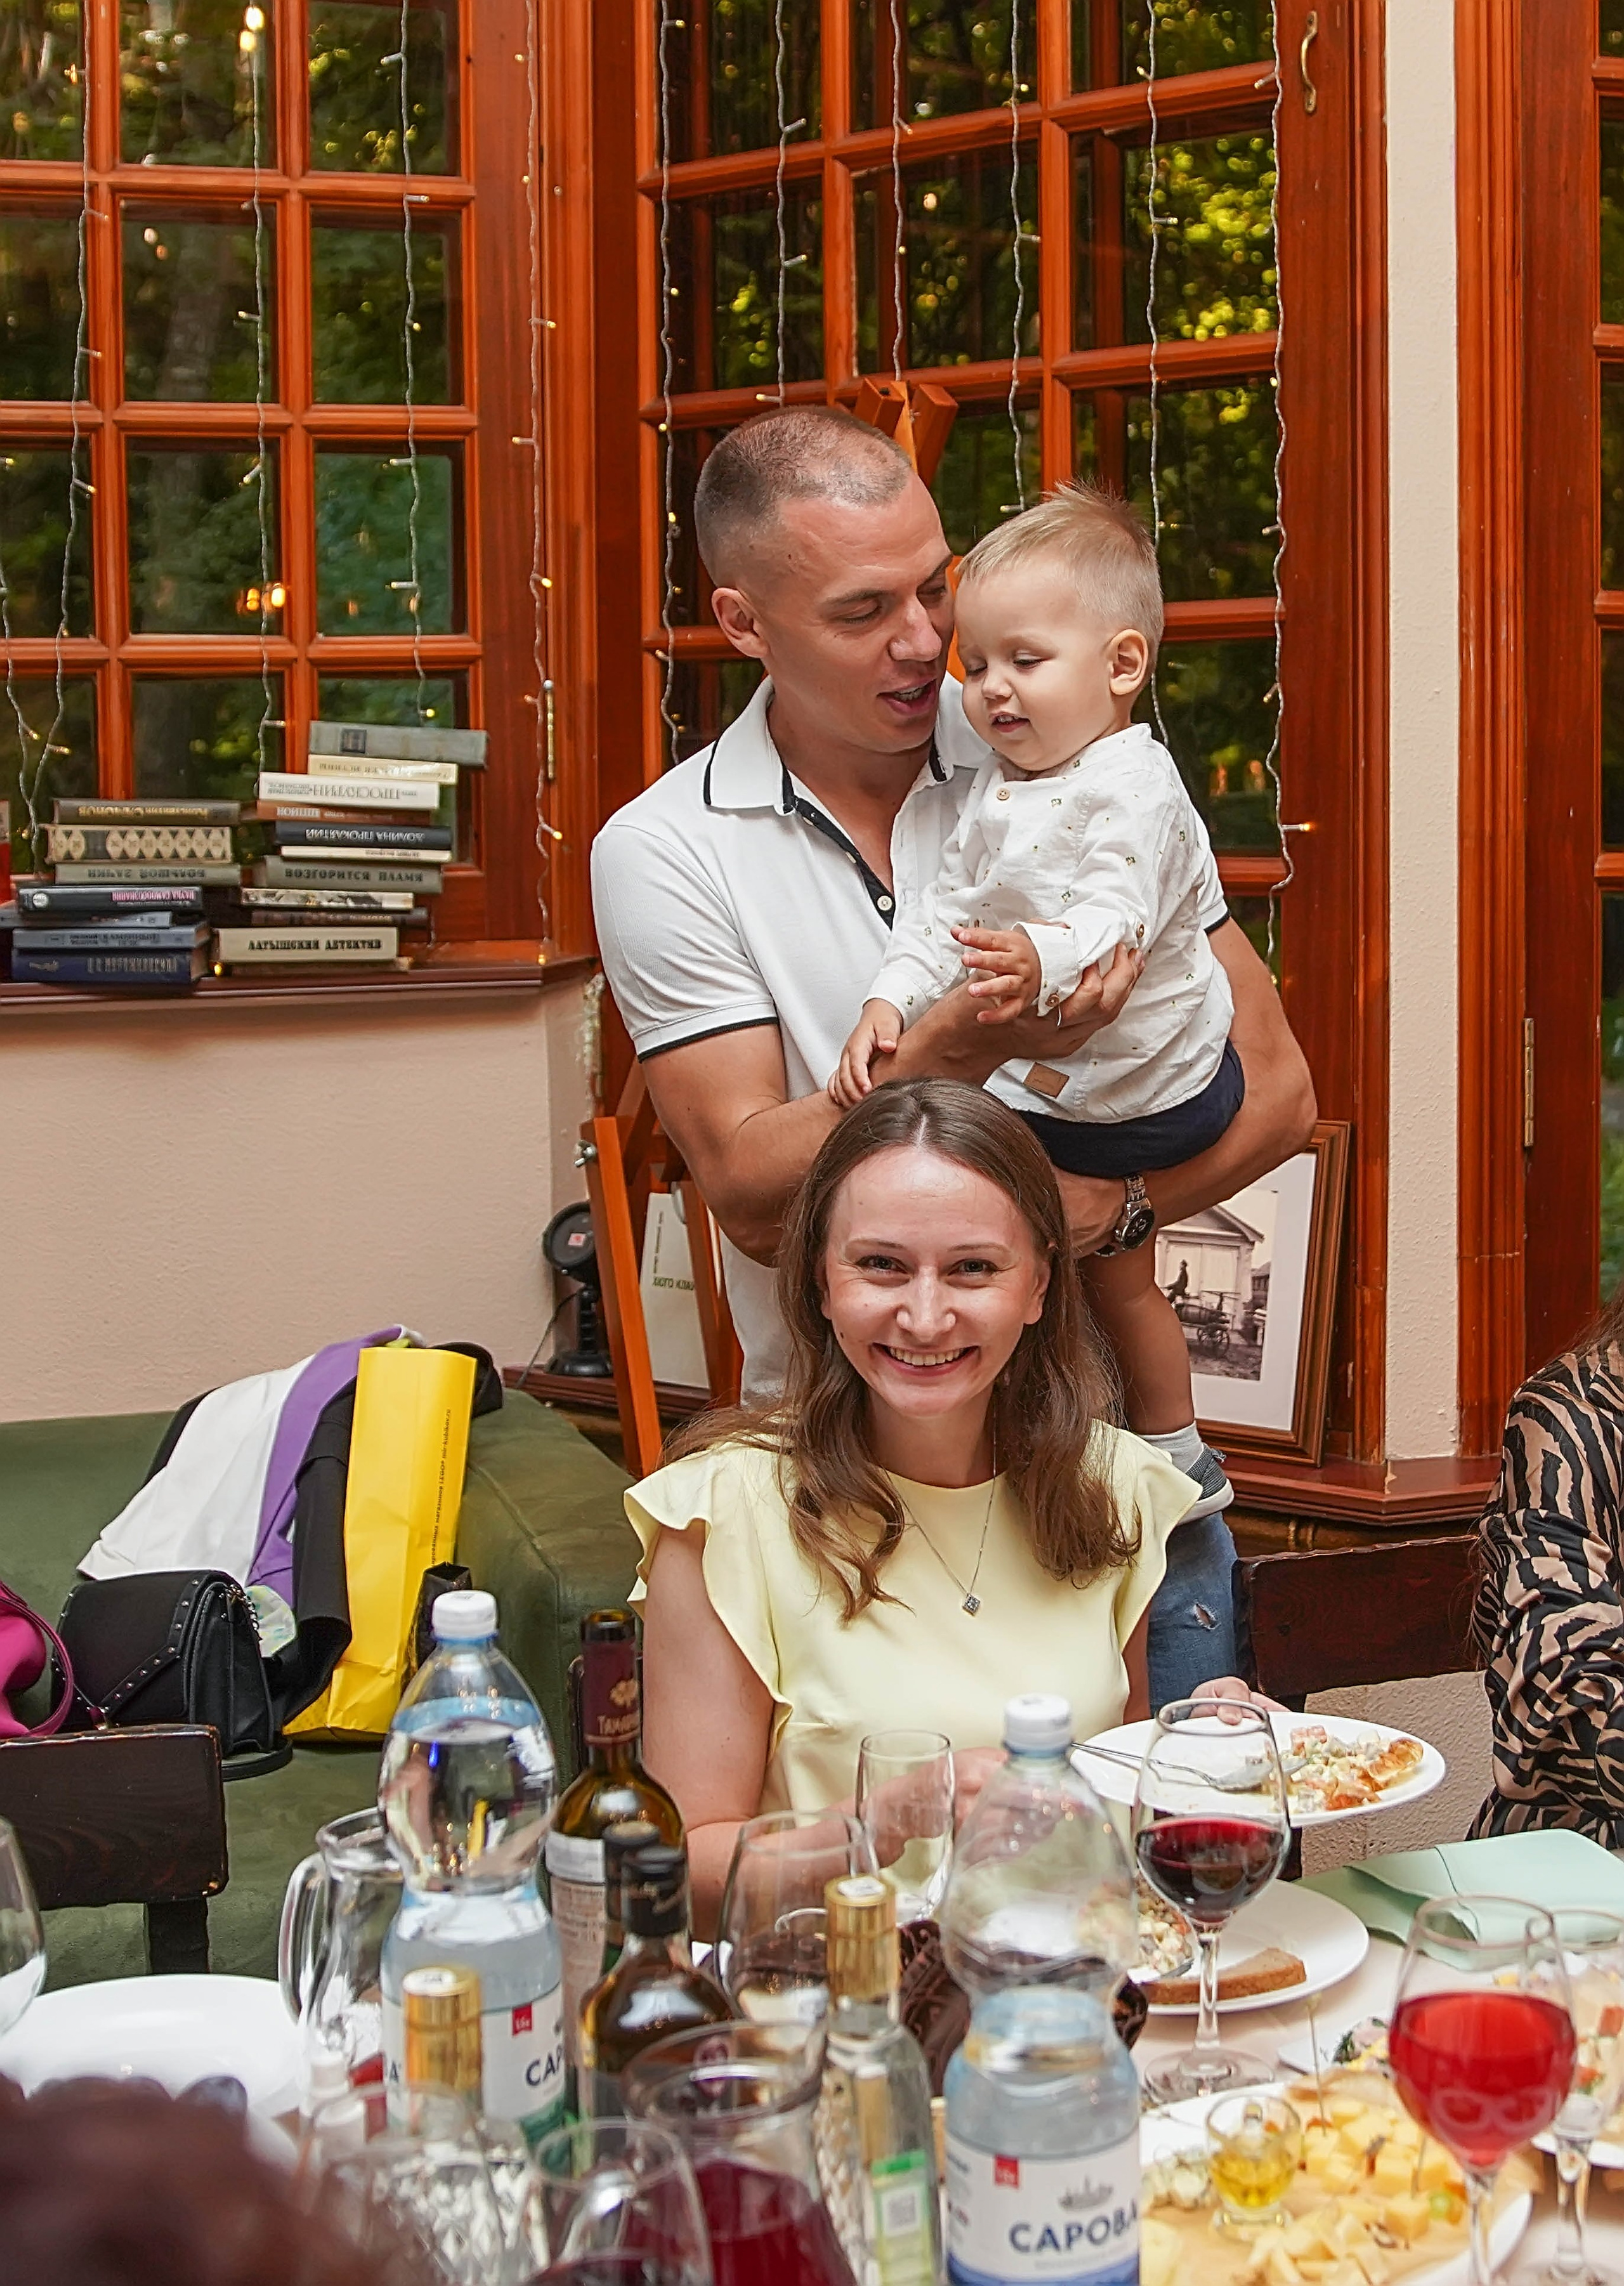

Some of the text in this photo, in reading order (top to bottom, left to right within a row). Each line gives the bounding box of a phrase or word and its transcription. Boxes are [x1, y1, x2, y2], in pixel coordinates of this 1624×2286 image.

[313, 784, 400, 799] ПРОСКУРИН
[277, 807, 320, 818] ШПИОН
[306, 828, 425, 842] ДОЛИНА ПРОКЛЯТИЙ
[285, 868, 423, 882] ВОЗГОРИТСЯ ПЛАМЯ
[171, 891, 195, 901] НАУКА
[248, 939, 381, 950] ЛАТЫШСКИЙ ДЕТЕКТИВ
